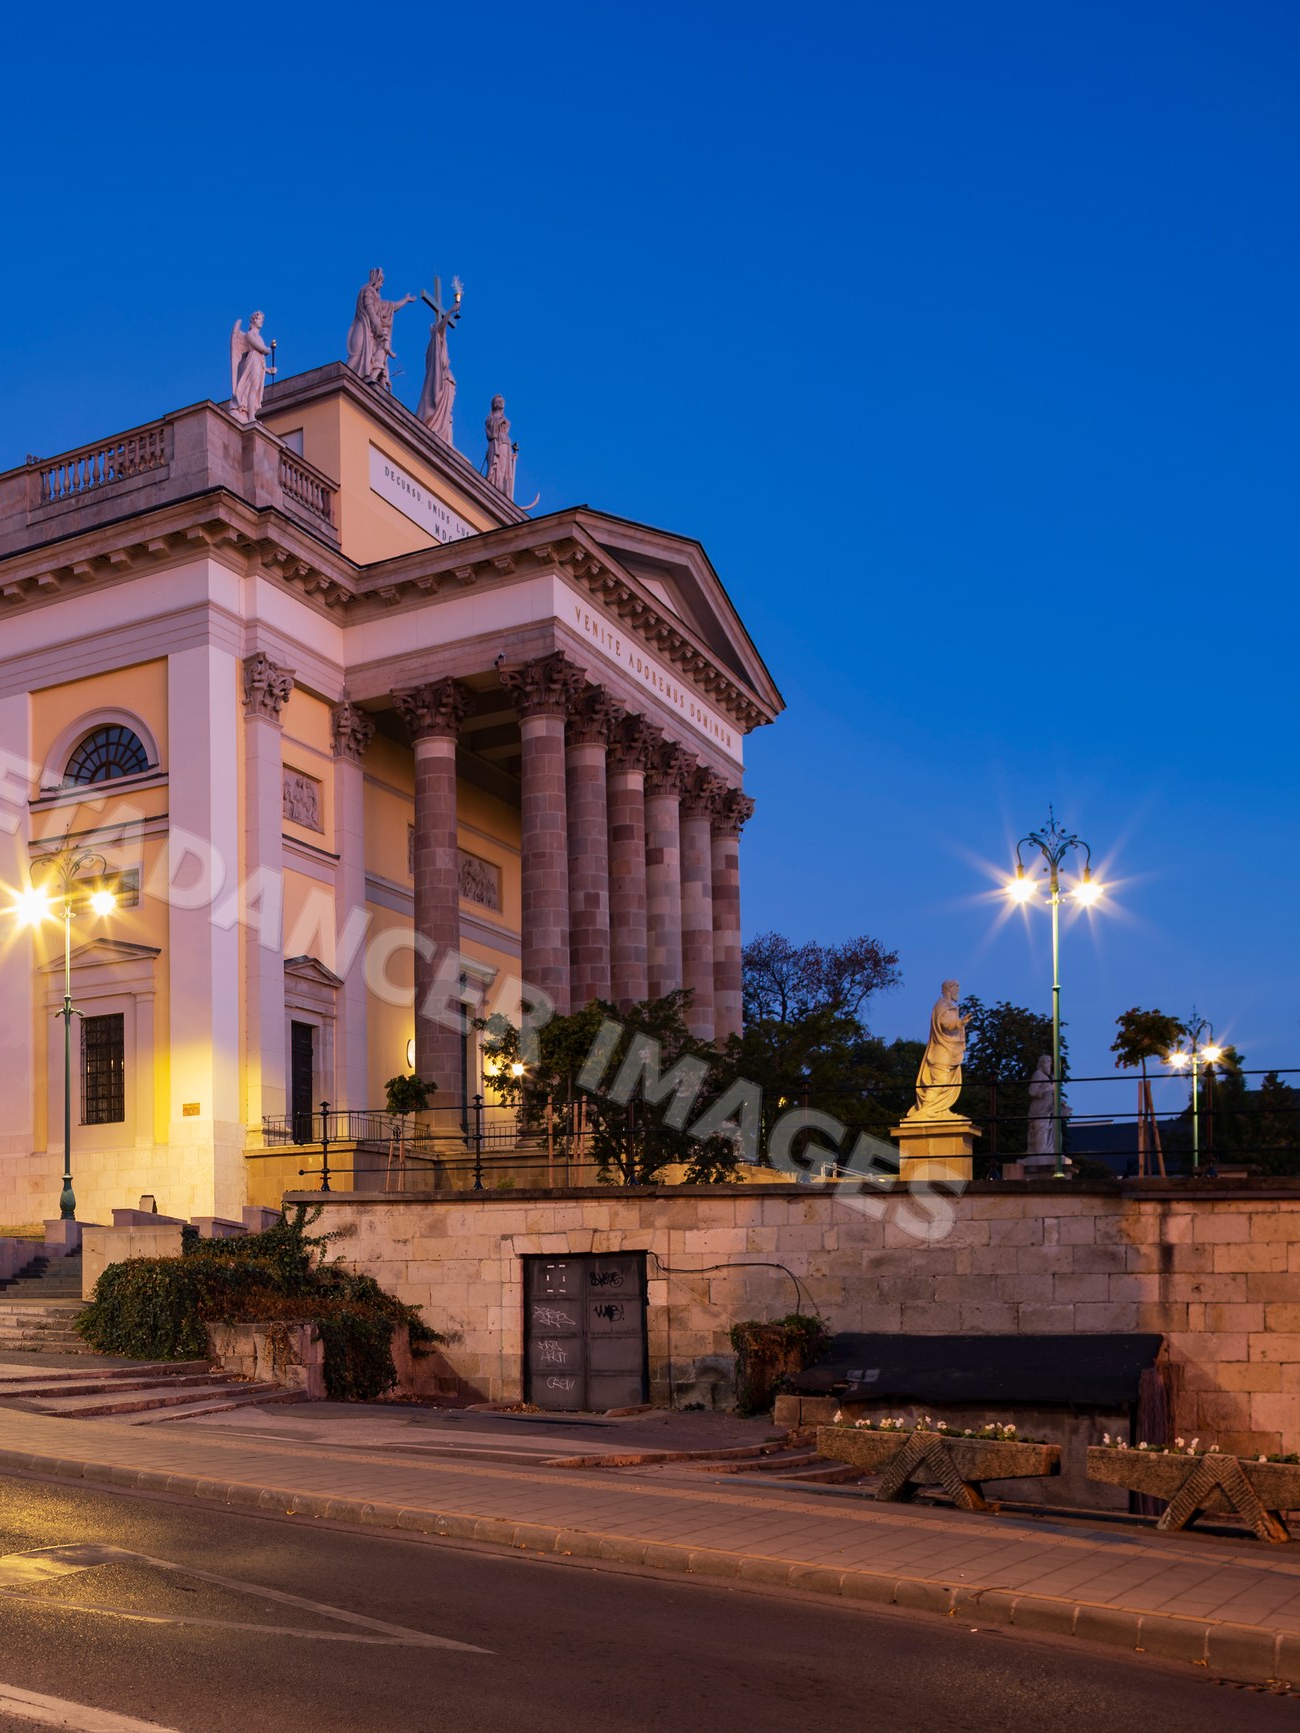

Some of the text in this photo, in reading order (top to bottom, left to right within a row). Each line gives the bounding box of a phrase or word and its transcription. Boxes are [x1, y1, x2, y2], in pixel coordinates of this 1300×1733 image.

[574, 606, 733, 748] VENITE ADOREMUS DOMINUM
